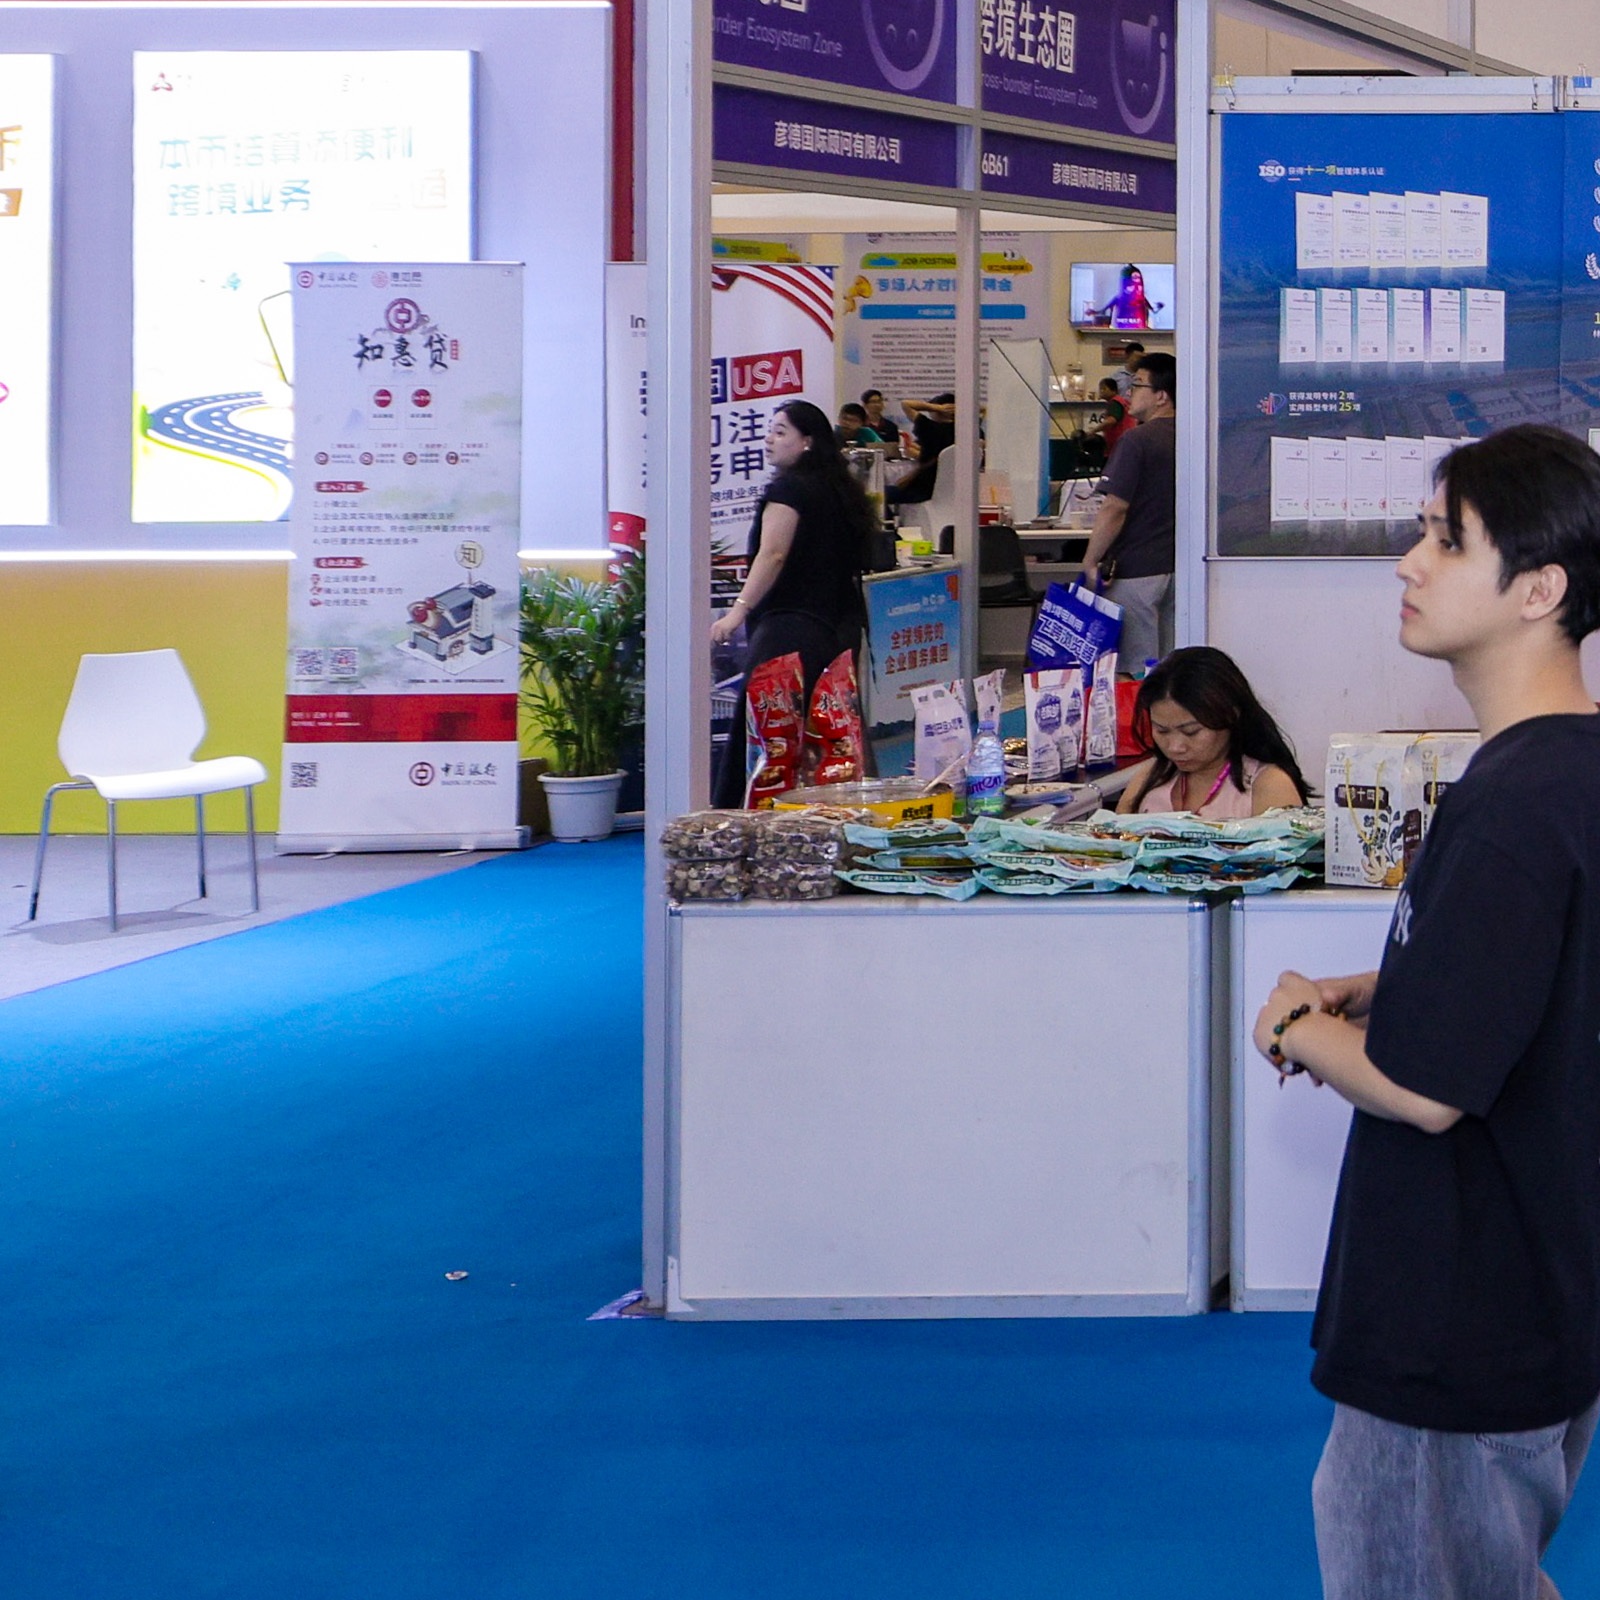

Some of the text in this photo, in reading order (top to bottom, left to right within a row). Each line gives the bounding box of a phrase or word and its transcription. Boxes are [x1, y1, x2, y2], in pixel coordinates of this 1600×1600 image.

[746, 16, 843, 58] Ecosystem Zone
[982, 71, 1098, 110] ross-border Ecosystem Zone
[773, 120, 901, 166] 彦德国际顾问有限公司
[981, 151, 1009, 180] 6B61
[1052, 162, 1138, 195] 彦德国际顾问有限公司
[1259, 164, 1286, 177] ISO
[733, 354, 801, 396] USA
